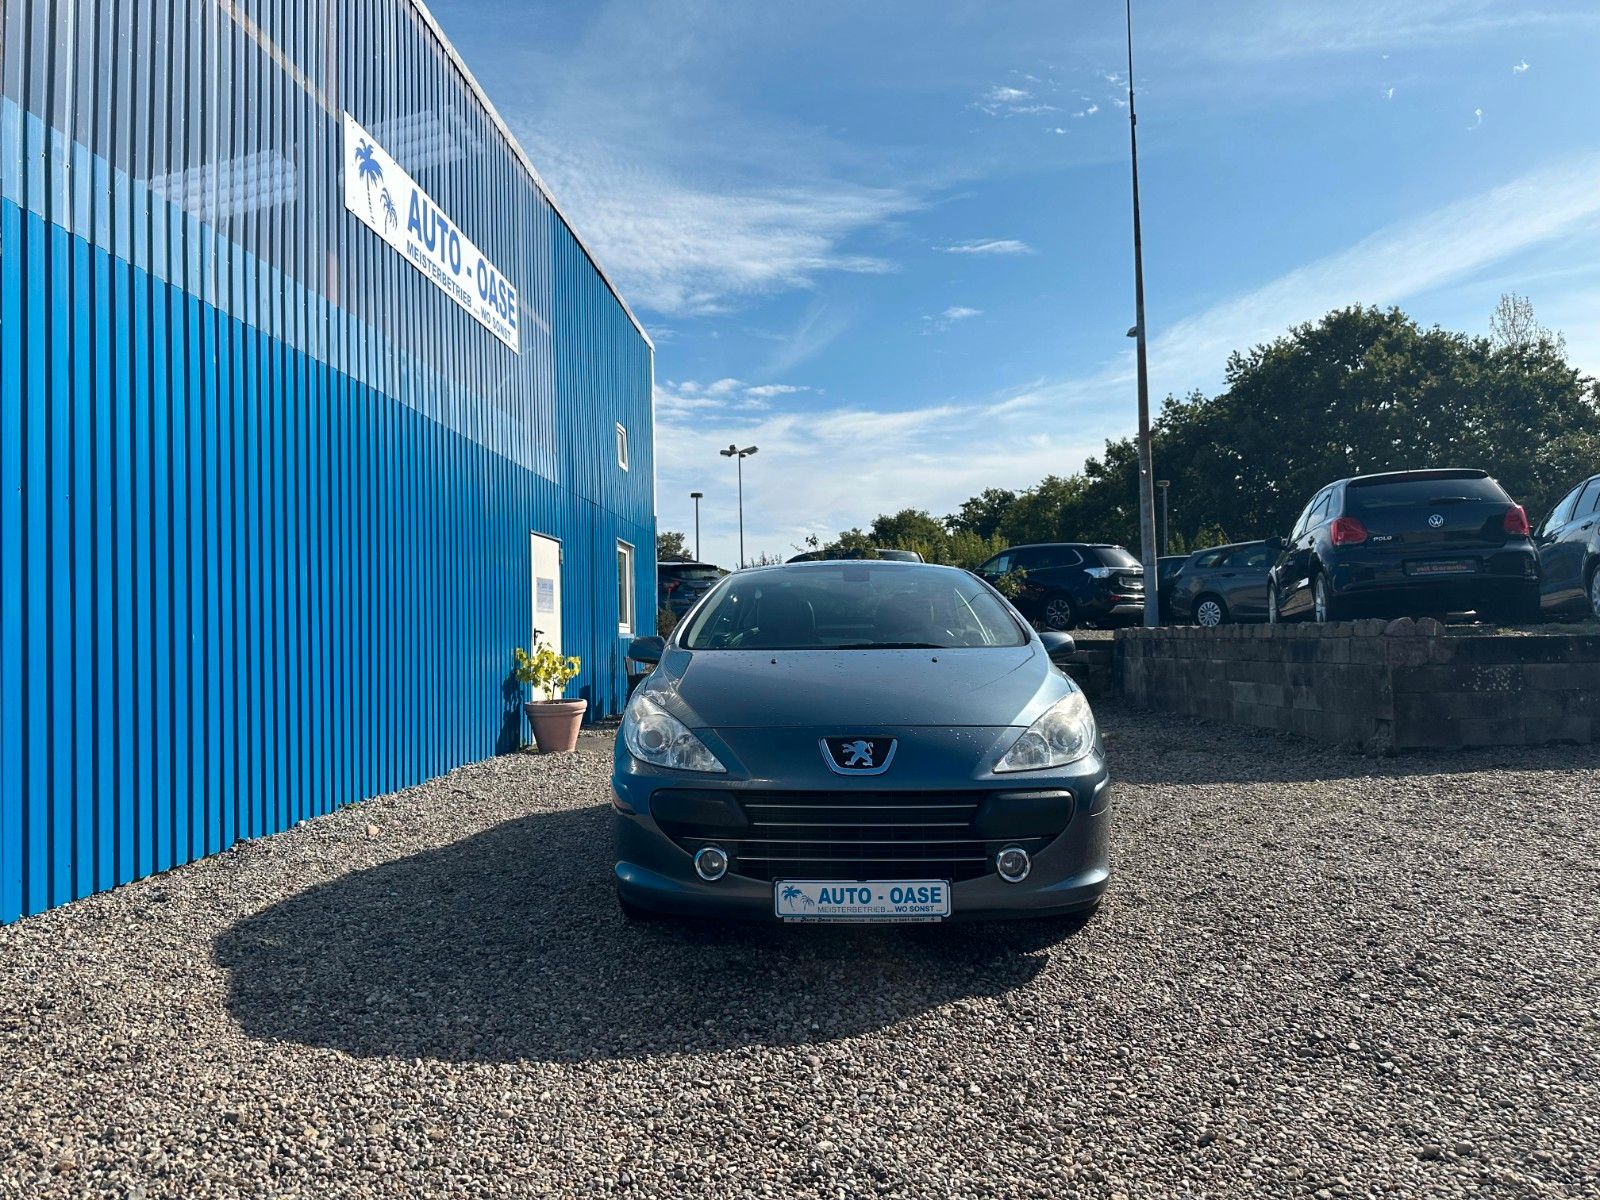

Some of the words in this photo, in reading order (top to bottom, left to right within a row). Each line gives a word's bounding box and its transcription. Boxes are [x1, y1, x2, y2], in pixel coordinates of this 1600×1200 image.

[407, 188, 462, 276] AUTO
[477, 258, 517, 330] OASE
[406, 240, 472, 308] MEISTERBETRIEB
[492, 317, 511, 341] SONST
[818, 887, 872, 904] AUTO
[889, 887, 942, 904] OASE
[894, 905, 908, 913] WO
